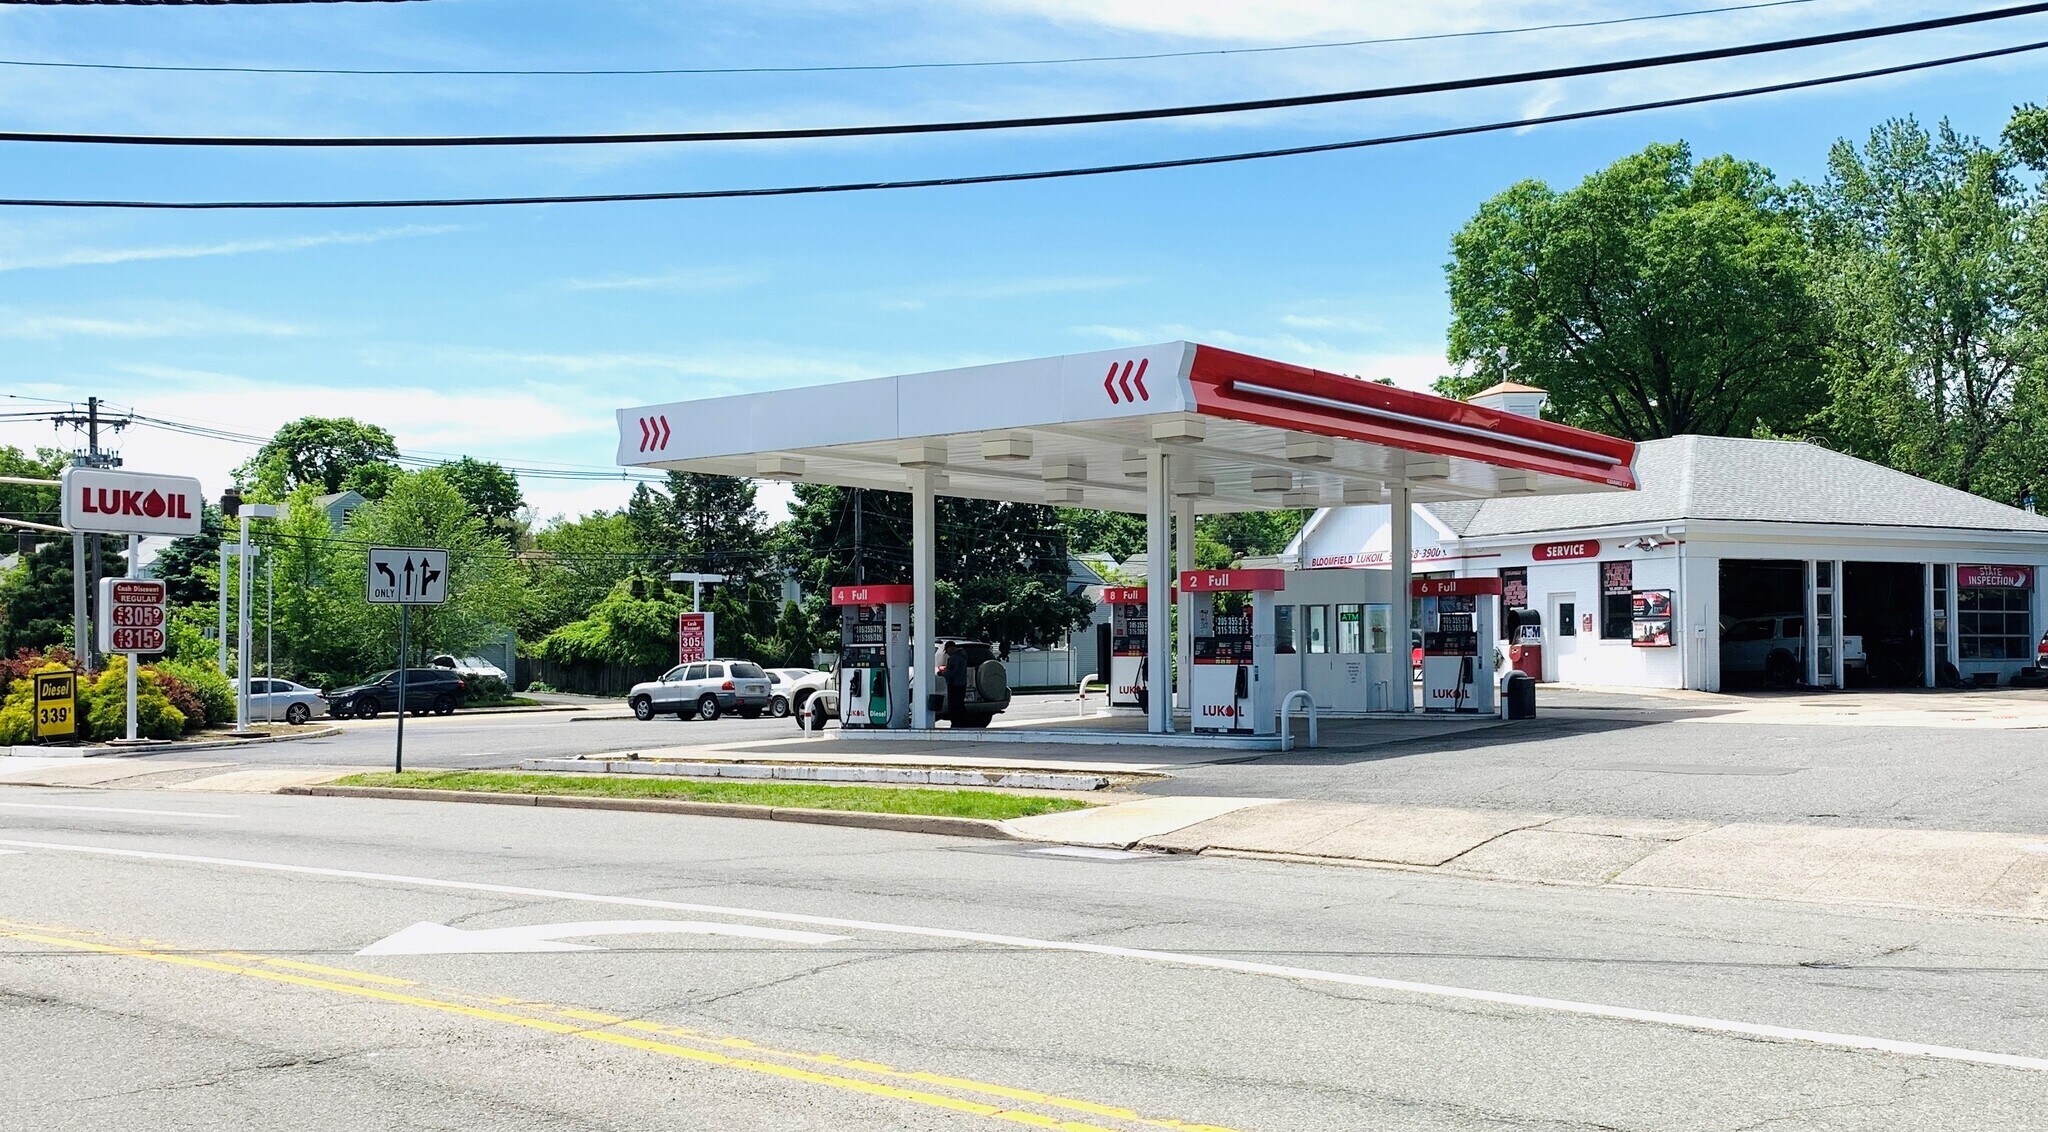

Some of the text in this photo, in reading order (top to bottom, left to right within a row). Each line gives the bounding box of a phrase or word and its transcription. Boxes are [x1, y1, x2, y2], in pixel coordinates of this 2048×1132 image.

[82, 487, 192, 520] LUKOIL
[1546, 544, 1585, 558] SERVICE
[1311, 555, 1354, 568] BLOOMFIELD
[1355, 552, 1384, 564] LUKOIL
[1979, 567, 2003, 577] STATE
[1189, 573, 1229, 588] 2 Full
[1968, 576, 2014, 586] INSPECTION
[117, 585, 160, 594] Cash Discount
[1421, 581, 1457, 593] 6 Full
[374, 588, 396, 598] ONLY
[838, 589, 868, 601] 4 Full
[1110, 590, 1139, 600] 8 Full
[120, 595, 158, 603] REGULAR
[1341, 613, 1359, 621] ATM
[42, 680, 70, 697] Diesel
[870, 710, 887, 718] Diesel
[1202, 704, 1245, 718] LUKOL
